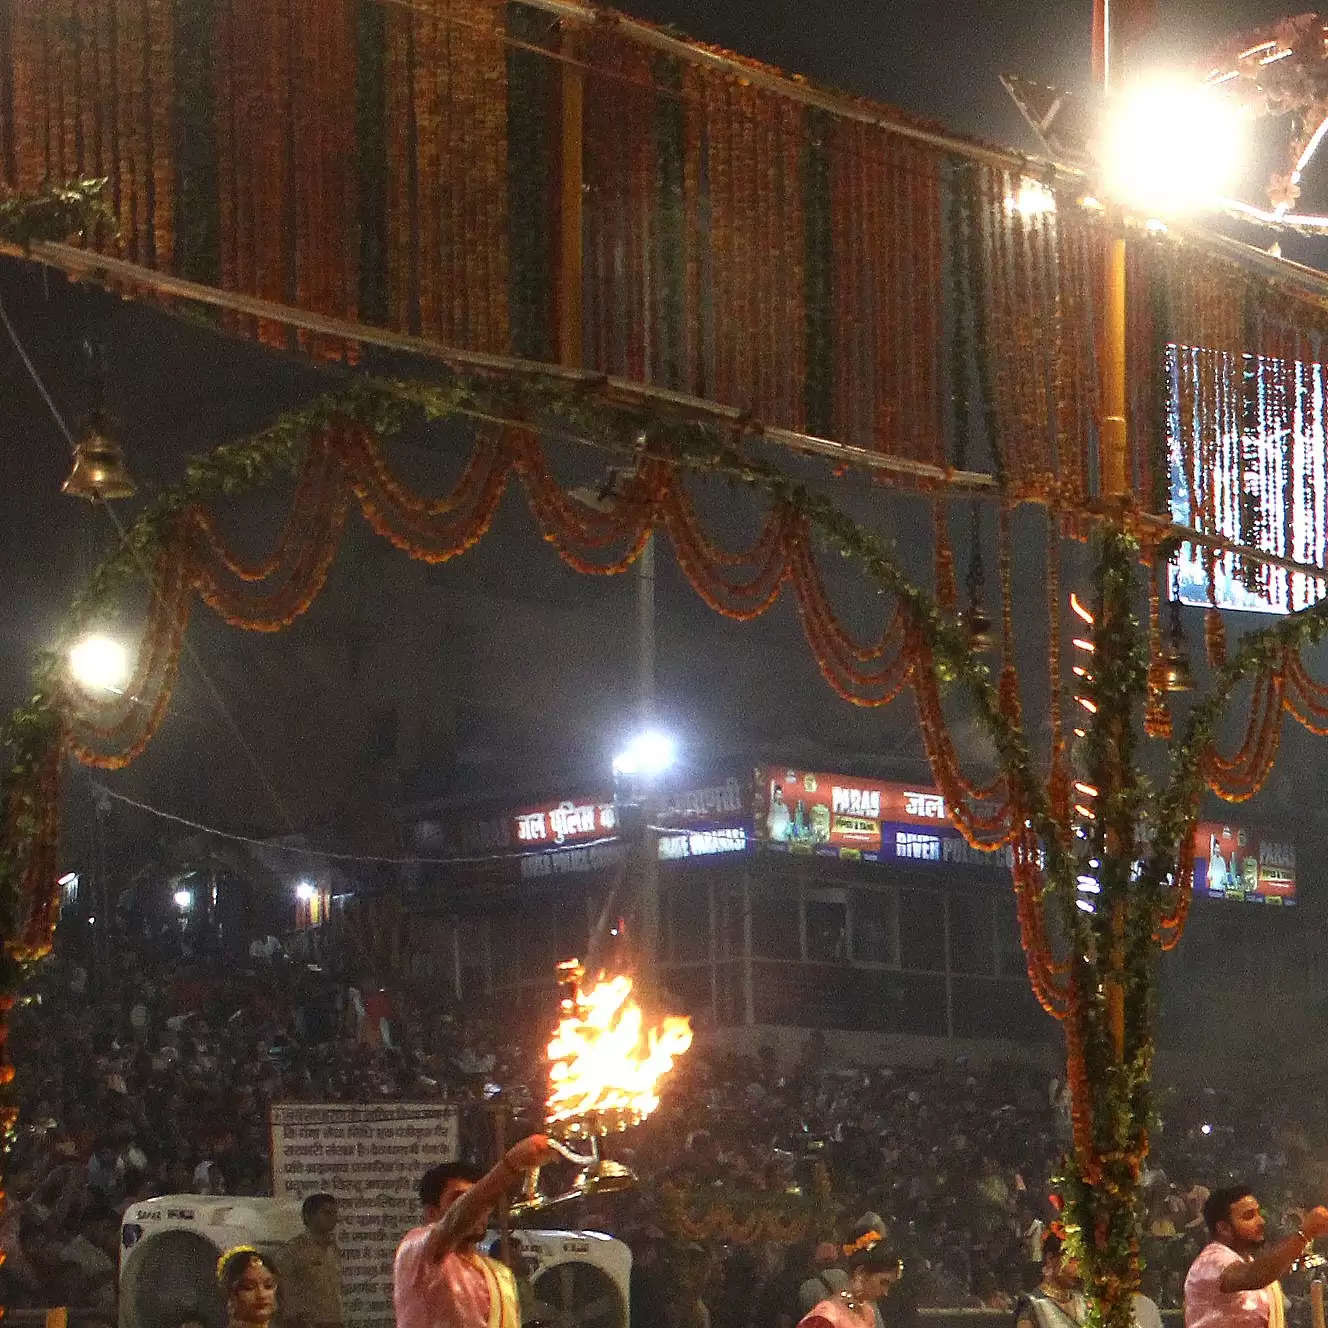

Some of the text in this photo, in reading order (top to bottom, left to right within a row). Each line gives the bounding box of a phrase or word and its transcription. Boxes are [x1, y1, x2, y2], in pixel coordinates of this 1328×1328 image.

[903, 791, 946, 819] जल
[515, 812, 547, 840] जल
[548, 801, 595, 844] पुलिस
[896, 832, 940, 860] RIVER
